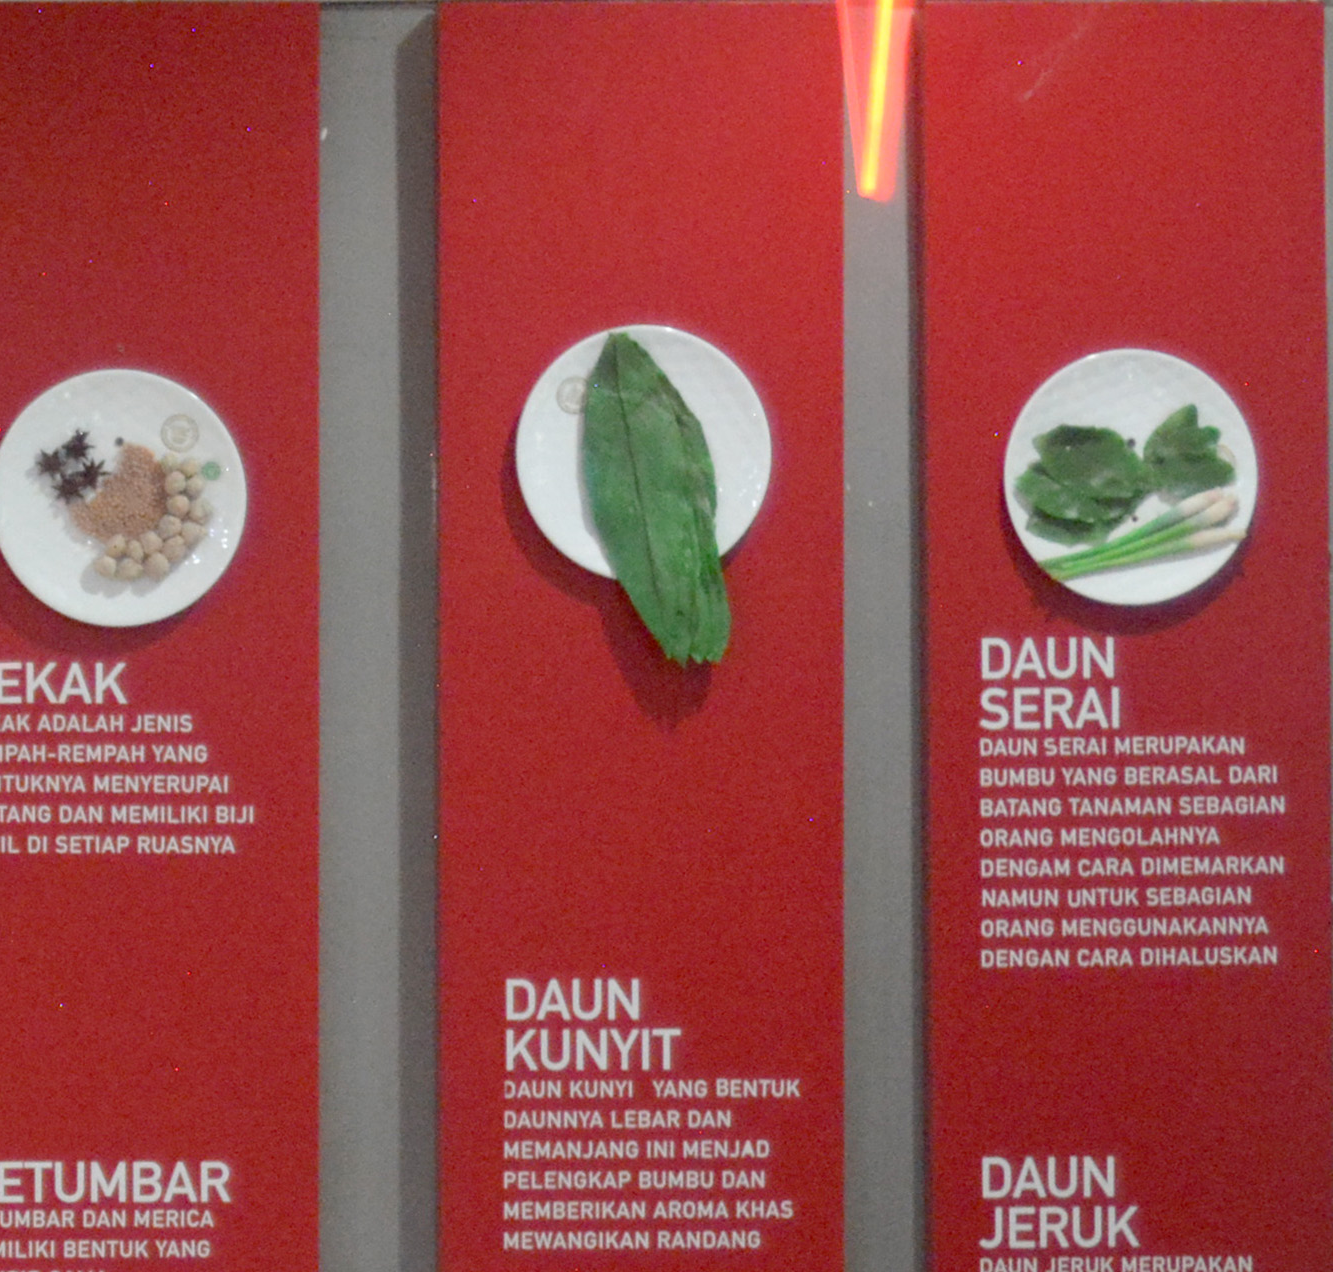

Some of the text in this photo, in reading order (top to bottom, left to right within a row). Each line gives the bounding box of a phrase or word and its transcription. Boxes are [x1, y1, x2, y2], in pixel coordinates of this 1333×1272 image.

[980, 635, 1116, 681] DAUN
[979, 686, 1121, 731] SERAI
[979, 764, 1278, 788] BUMBU YANG BERASAL DARI
[59, 804, 103, 824] DAN
[111, 805, 208, 824] MEMILIKI
[215, 805, 255, 825] BIJI
[979, 795, 1286, 818] BATANG TANAMAN SEBAGIAN
[980, 945, 1279, 969] DENGAN CARA DIHALUSKAN
[505, 977, 641, 1021] DAUN
[505, 1027, 683, 1072] KUNYIT
[503, 1109, 732, 1130] DAUNNYA LEBAR DAN
[503, 1170, 766, 1190] PELENGKAP BUMBU DAN
[981, 1154, 1116, 1200] DAUN
[83, 1210, 126, 1228] DAN
[134, 1209, 215, 1228] MERICA
[503, 1199, 794, 1220] MEMBERIKAN AROMA KHAS
[978, 1205, 1141, 1250] JERUK
[63, 1239, 149, 1259] BENTUK
[155, 1239, 212, 1259] YANG
[503, 1229, 762, 1251] MEWANGIKAN RANDANG
